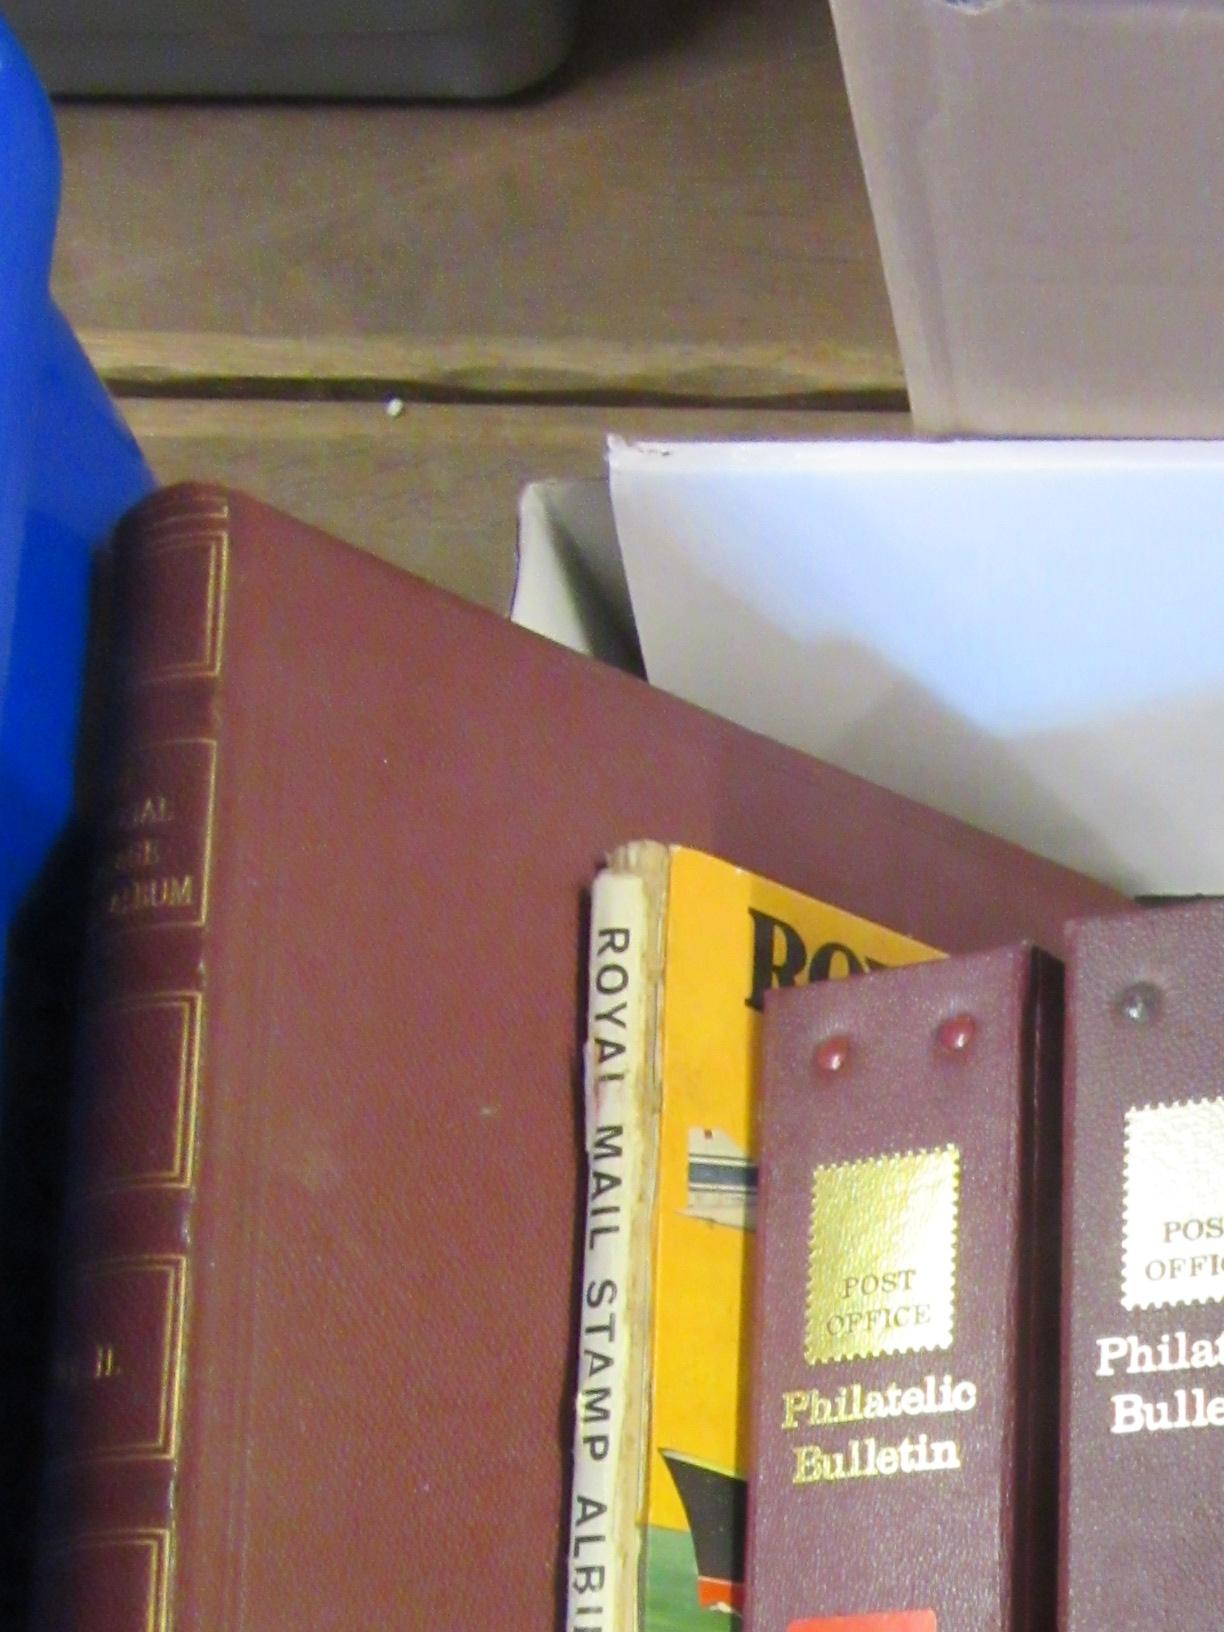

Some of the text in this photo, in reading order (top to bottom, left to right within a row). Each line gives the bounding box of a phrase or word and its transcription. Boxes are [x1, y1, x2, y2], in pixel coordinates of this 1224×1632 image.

[594, 927, 629, 1087] ROYAL
[587, 1124, 624, 1248] MAIL
[843, 1269, 917, 1298] POST
[826, 1303, 932, 1338] OFFICE
[580, 1278, 619, 1462] STAMP
[781, 1375, 977, 1429] Philatelic
[793, 1432, 962, 1484] Bulletin
